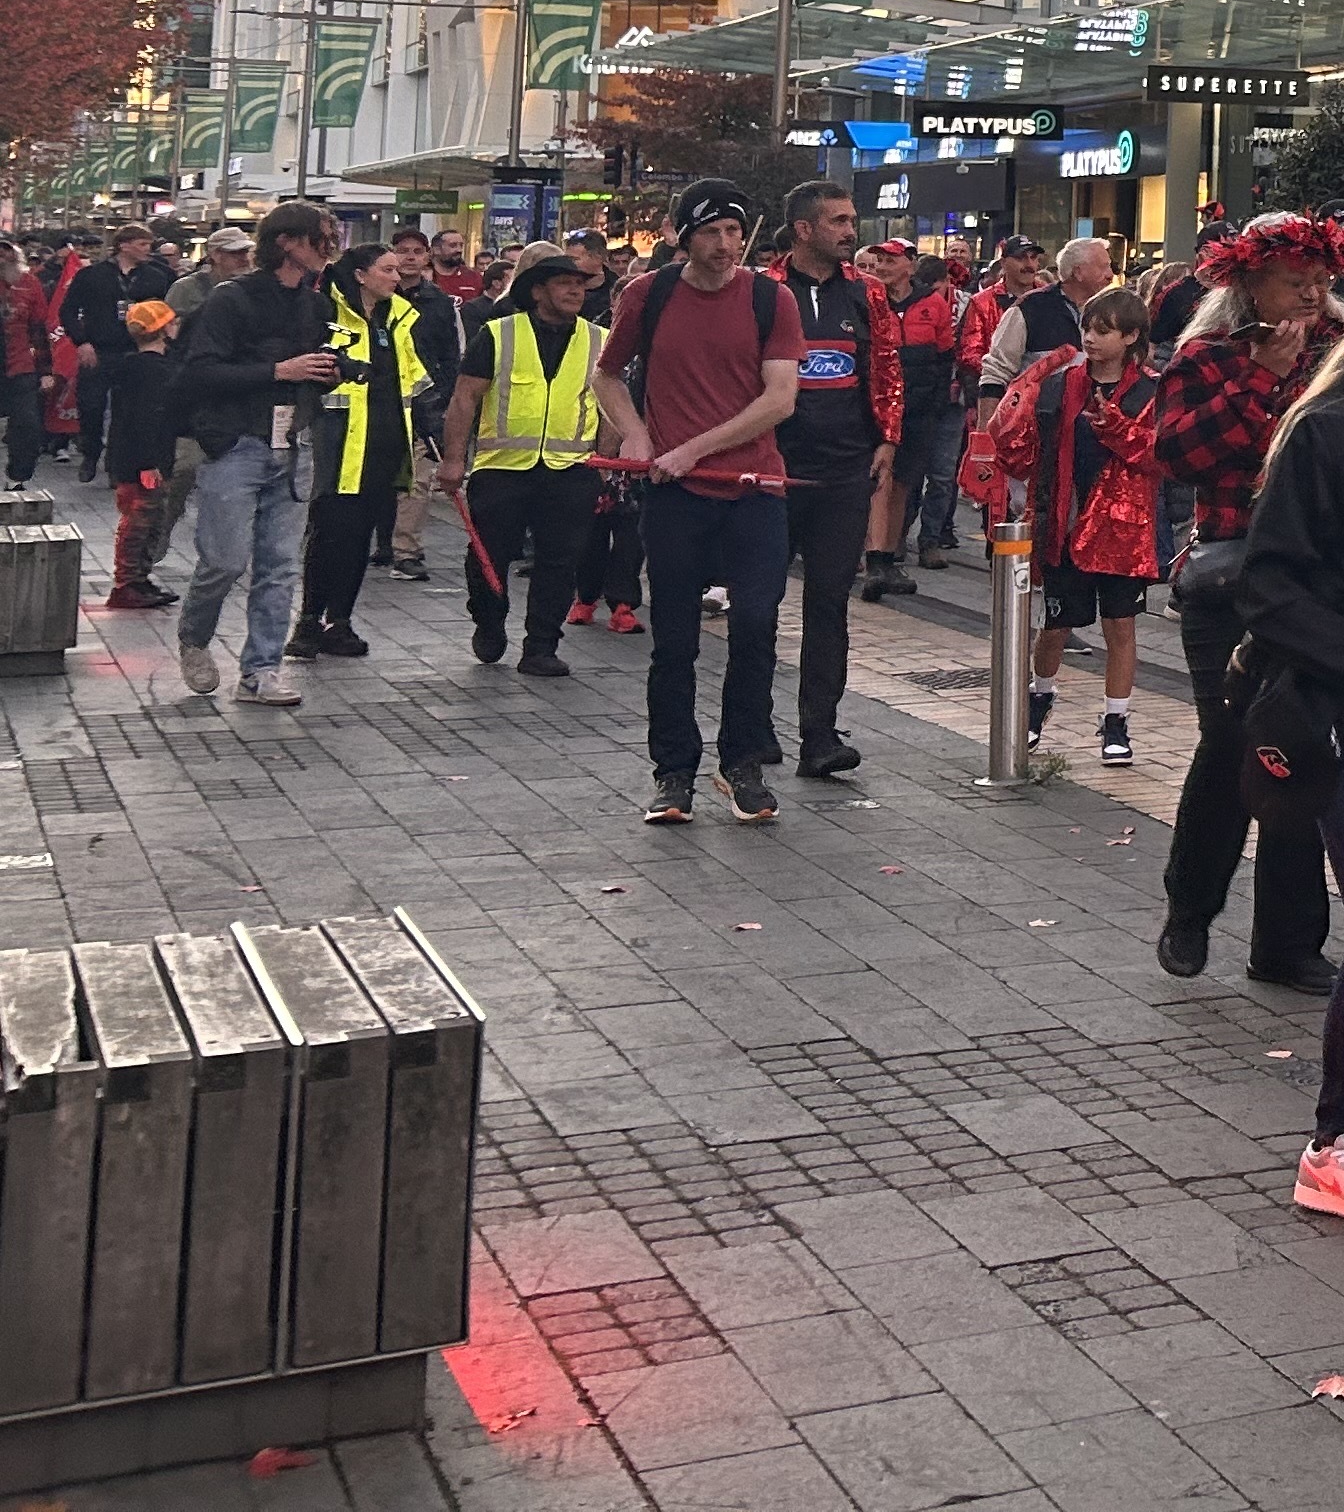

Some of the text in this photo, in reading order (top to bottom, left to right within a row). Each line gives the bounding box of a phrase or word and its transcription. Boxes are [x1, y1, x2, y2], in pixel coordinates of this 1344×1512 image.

[1160, 75, 1298, 97] SUPERETTE
[922, 116, 1037, 136] PLATYPUS
[1060, 145, 1122, 178] PLATYPUS
[799, 353, 844, 374] Ford
